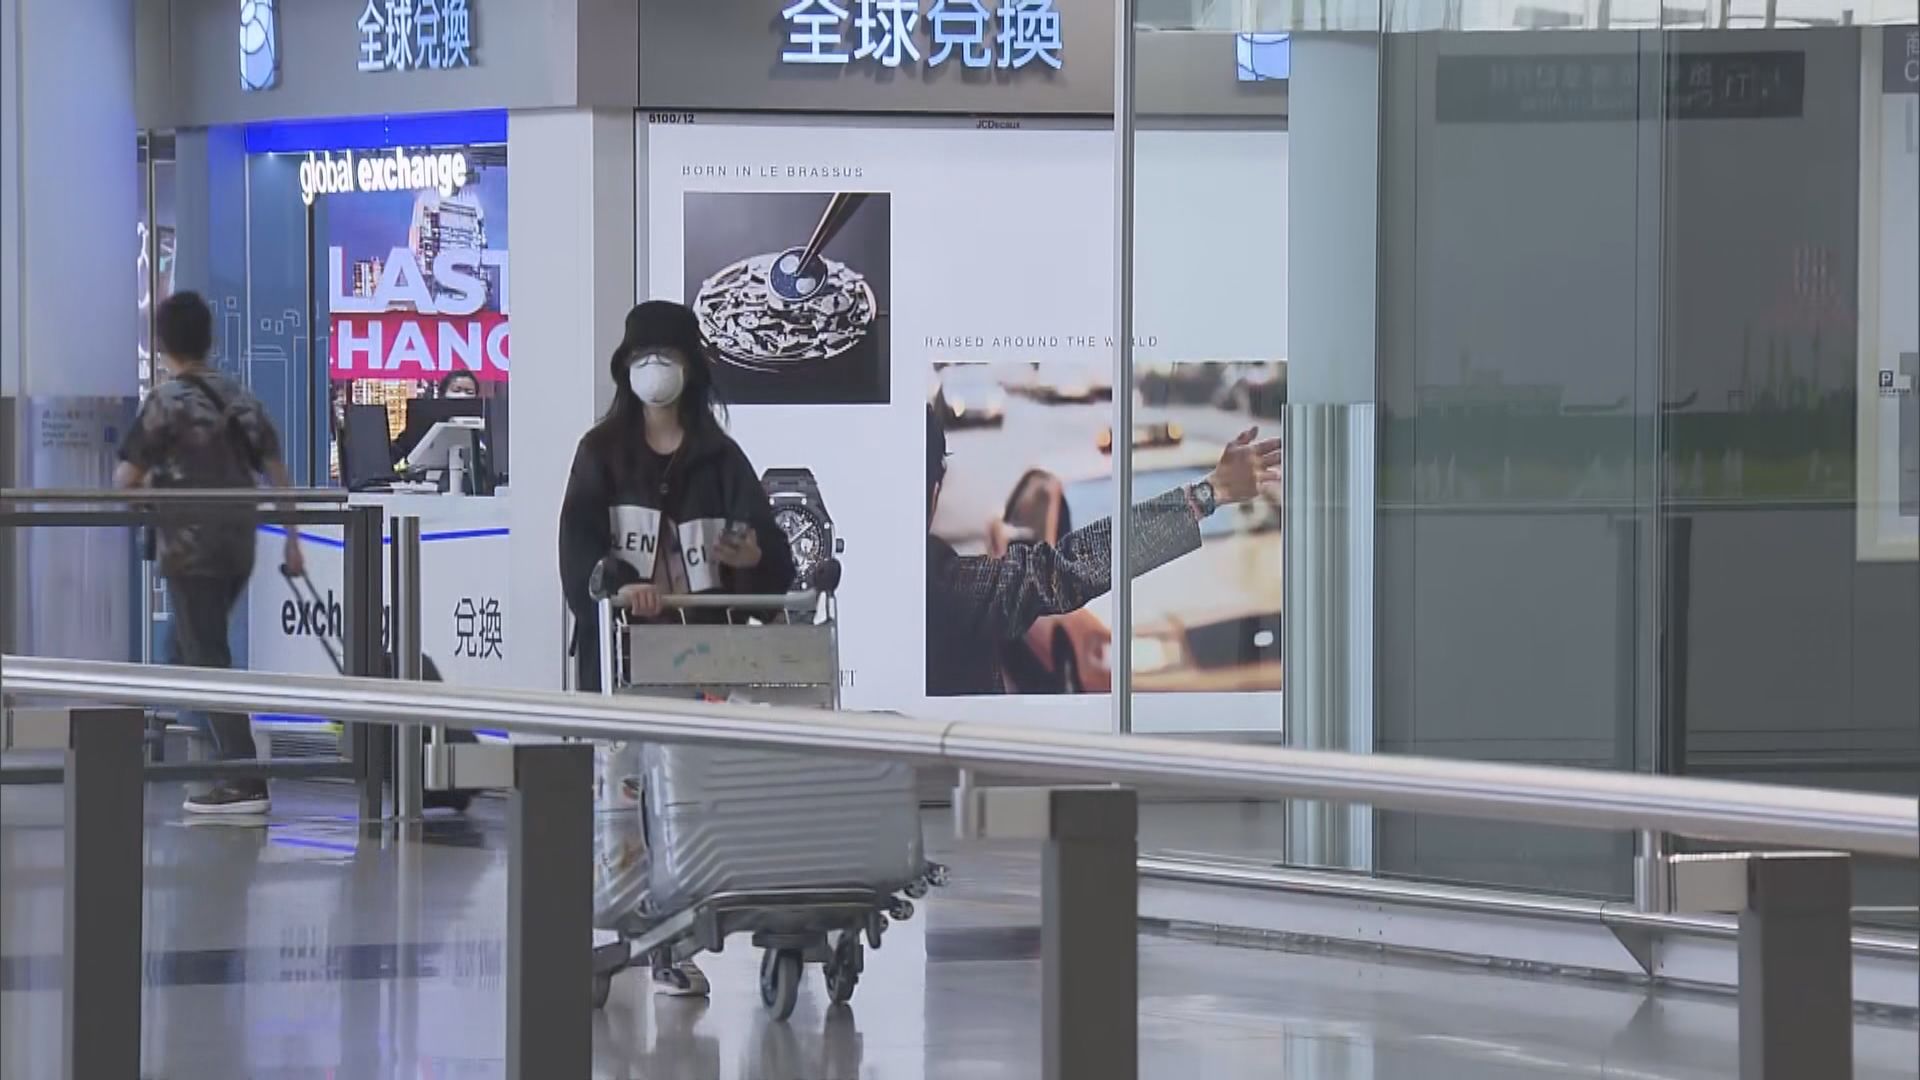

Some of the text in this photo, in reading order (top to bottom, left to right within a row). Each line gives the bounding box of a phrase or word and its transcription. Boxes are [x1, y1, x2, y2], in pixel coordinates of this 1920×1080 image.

[300, 146, 467, 205] global exchange
[682, 165, 863, 178] BORN IN LE BRASSUS
[925, 336, 1158, 348] RAISED AROUND THE WLD
[454, 597, 502, 660] 兌換
